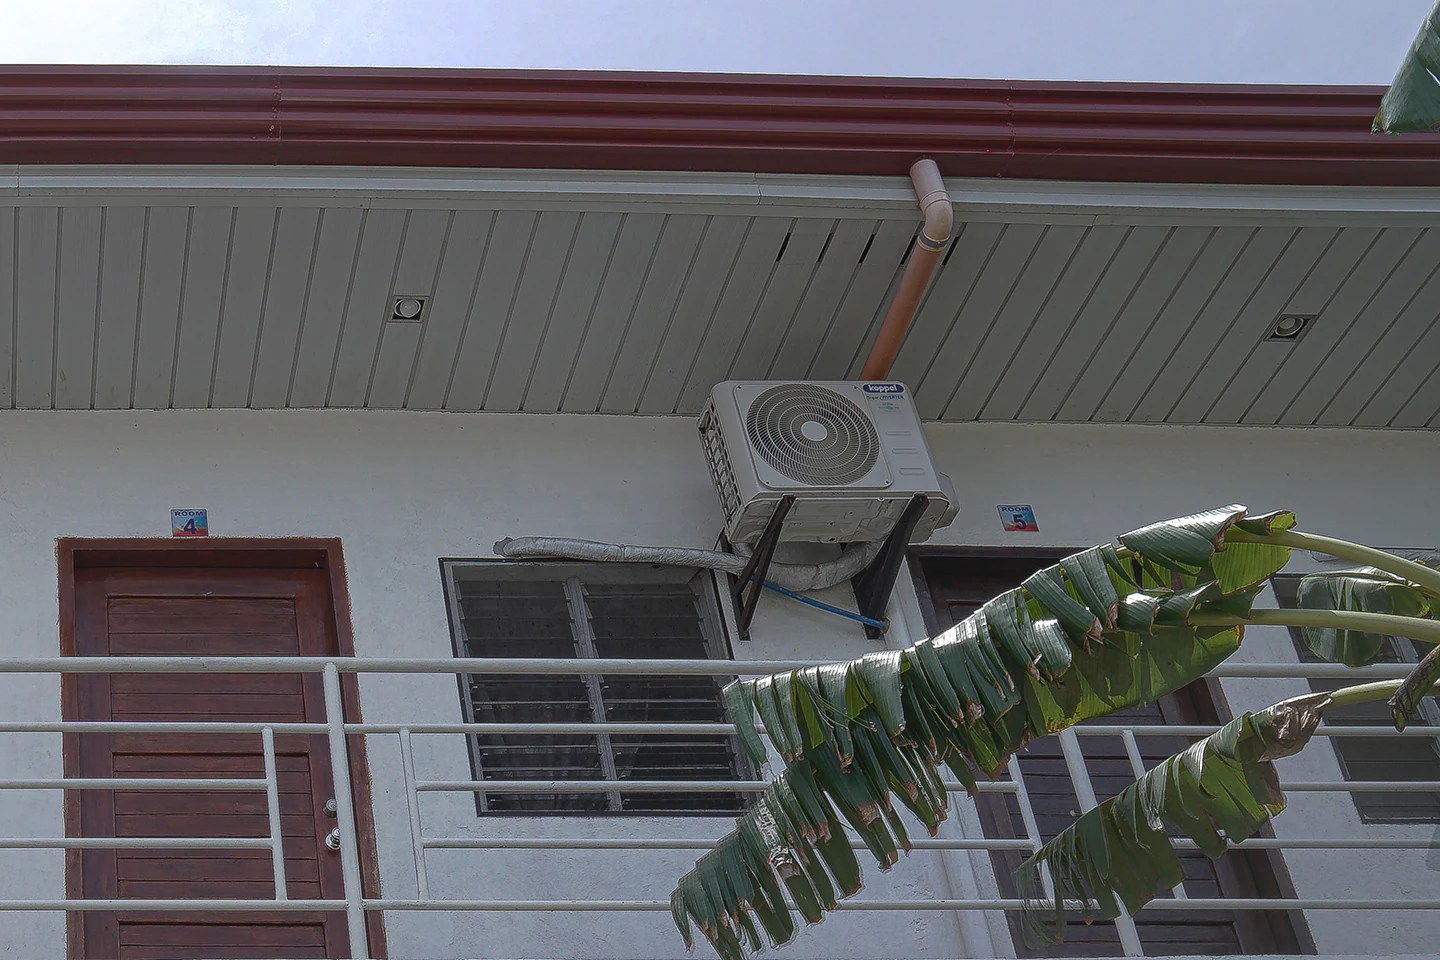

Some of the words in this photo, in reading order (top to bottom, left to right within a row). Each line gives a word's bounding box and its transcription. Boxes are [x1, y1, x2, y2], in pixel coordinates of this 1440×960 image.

[868, 384, 898, 392] koppel
[183, 518, 198, 535] 4
[1012, 513, 1027, 530] 5
